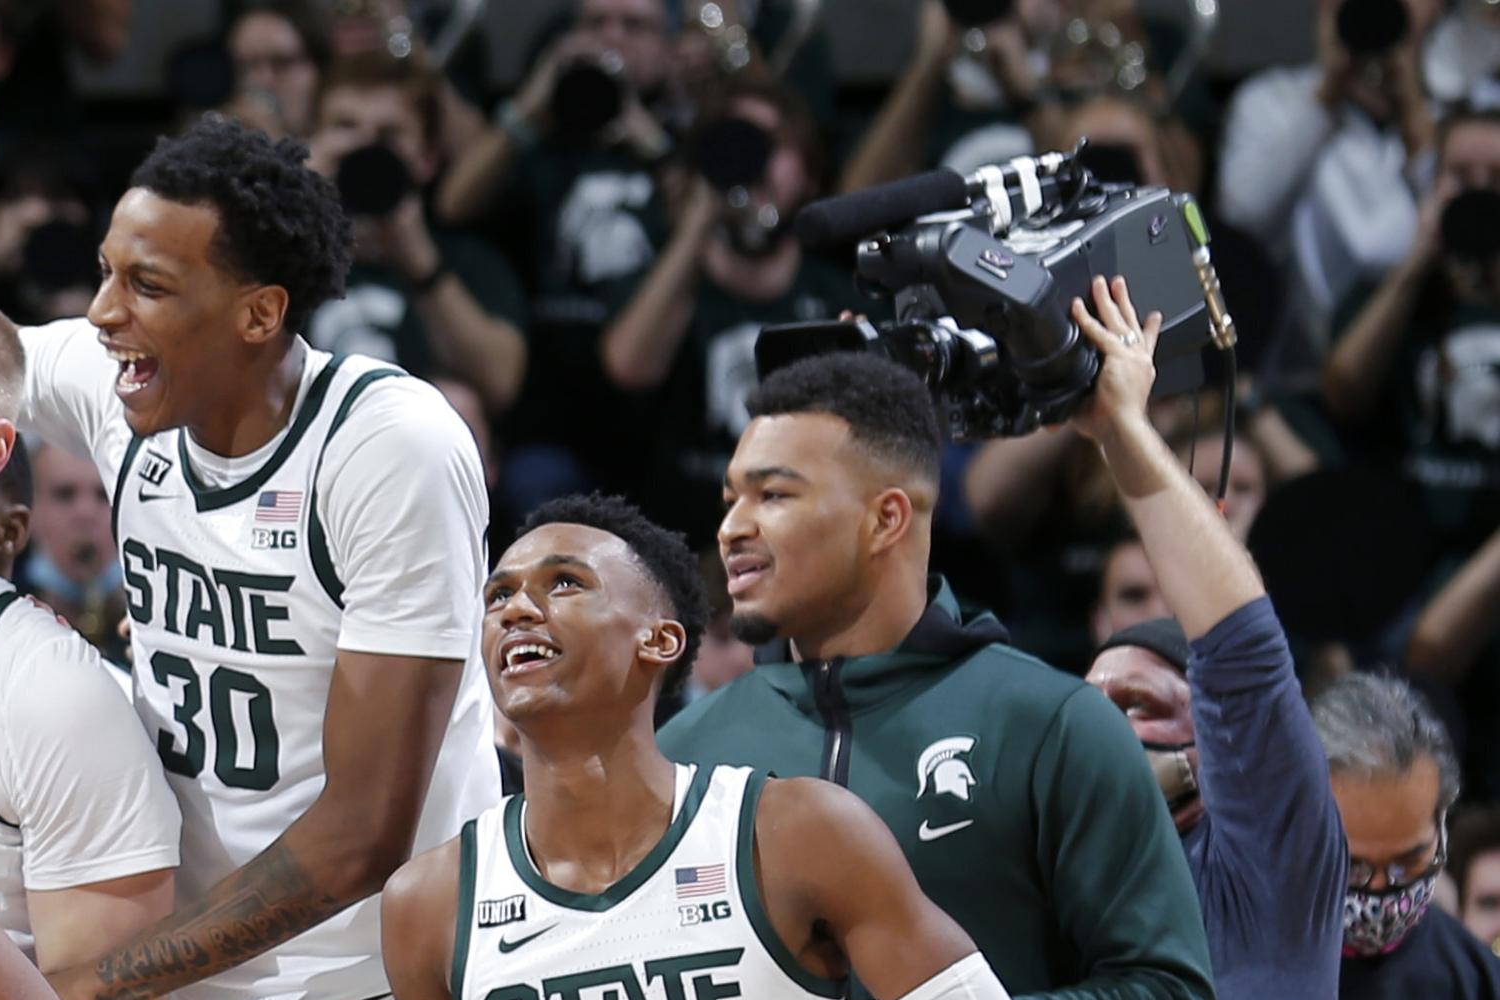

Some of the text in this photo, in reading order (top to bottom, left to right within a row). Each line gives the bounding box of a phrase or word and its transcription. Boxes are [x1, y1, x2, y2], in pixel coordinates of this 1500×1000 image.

[122, 537, 306, 656] STATE
[149, 650, 280, 792] 30
[478, 895, 525, 927] UNITY
